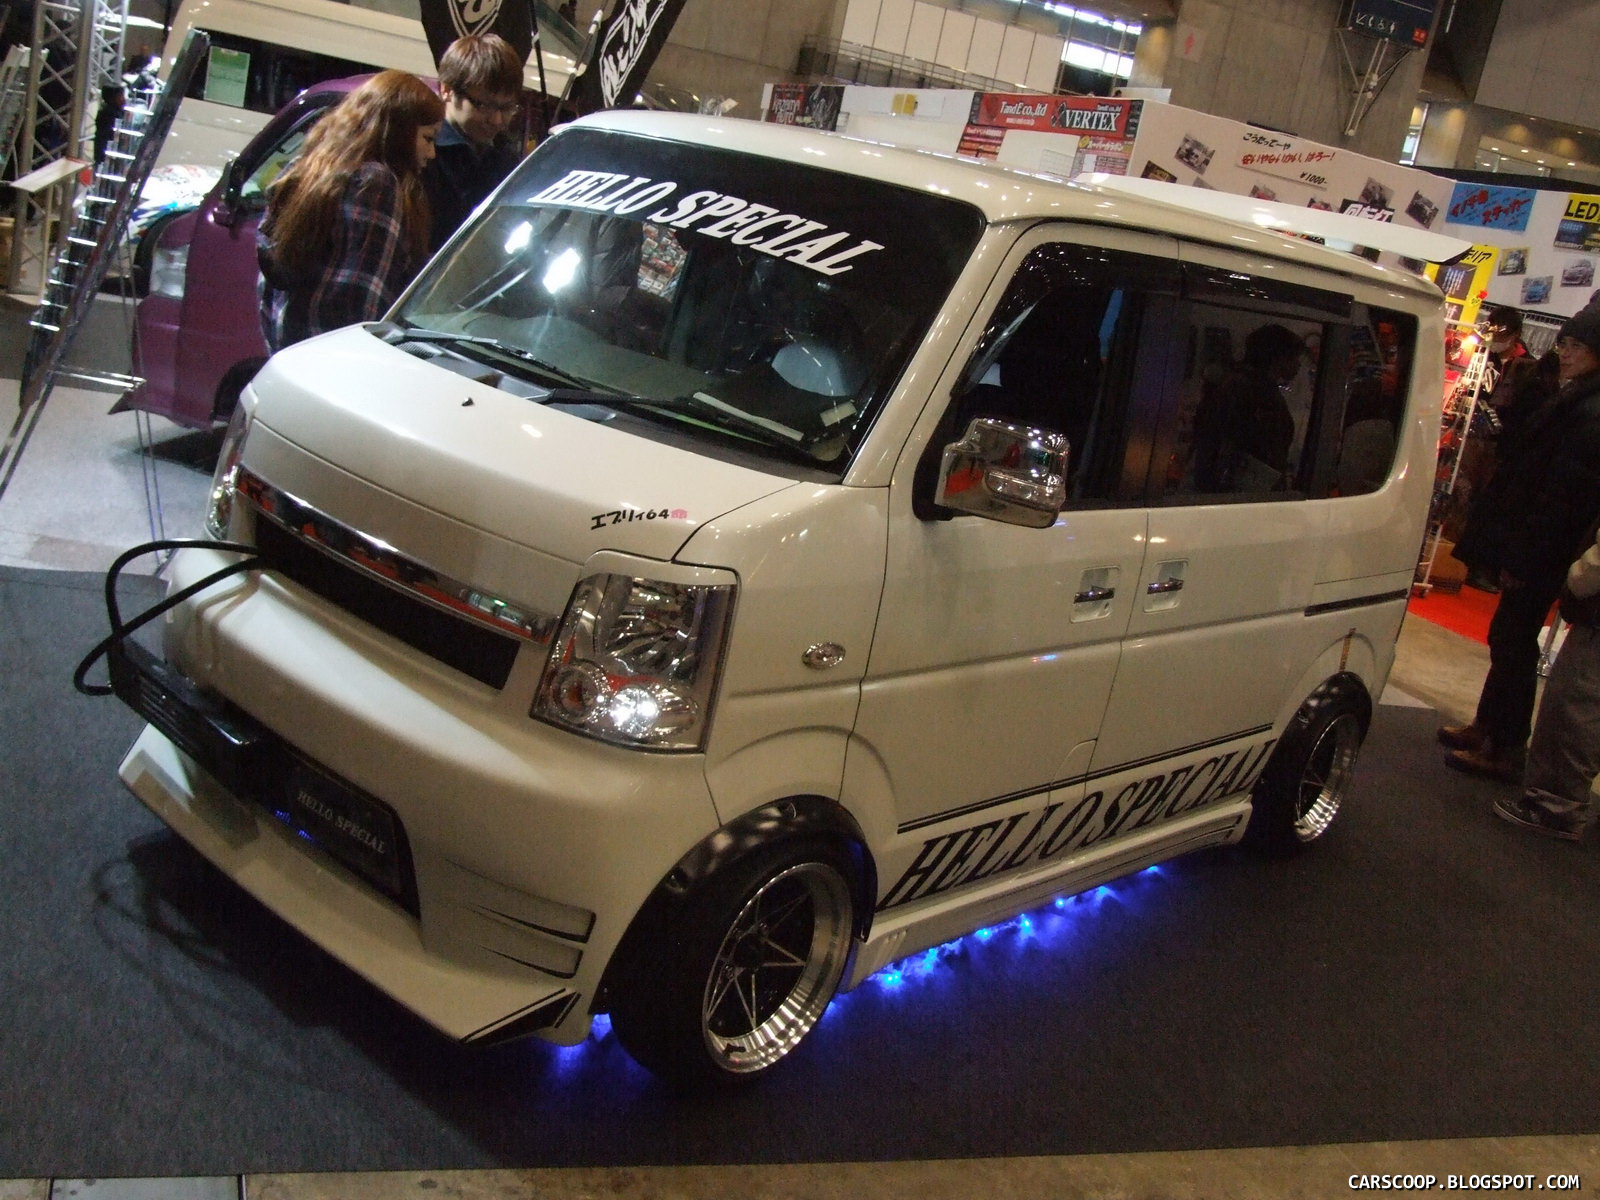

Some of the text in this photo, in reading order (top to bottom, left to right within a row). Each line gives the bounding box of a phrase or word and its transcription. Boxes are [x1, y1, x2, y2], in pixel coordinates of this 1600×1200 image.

[1065, 109, 1120, 131] VERTEX
[526, 170, 885, 276] HELLO SPECIAL
[297, 790, 386, 855] HELLO SPECIAL
[874, 738, 1277, 912] HELLO SPECIAL
